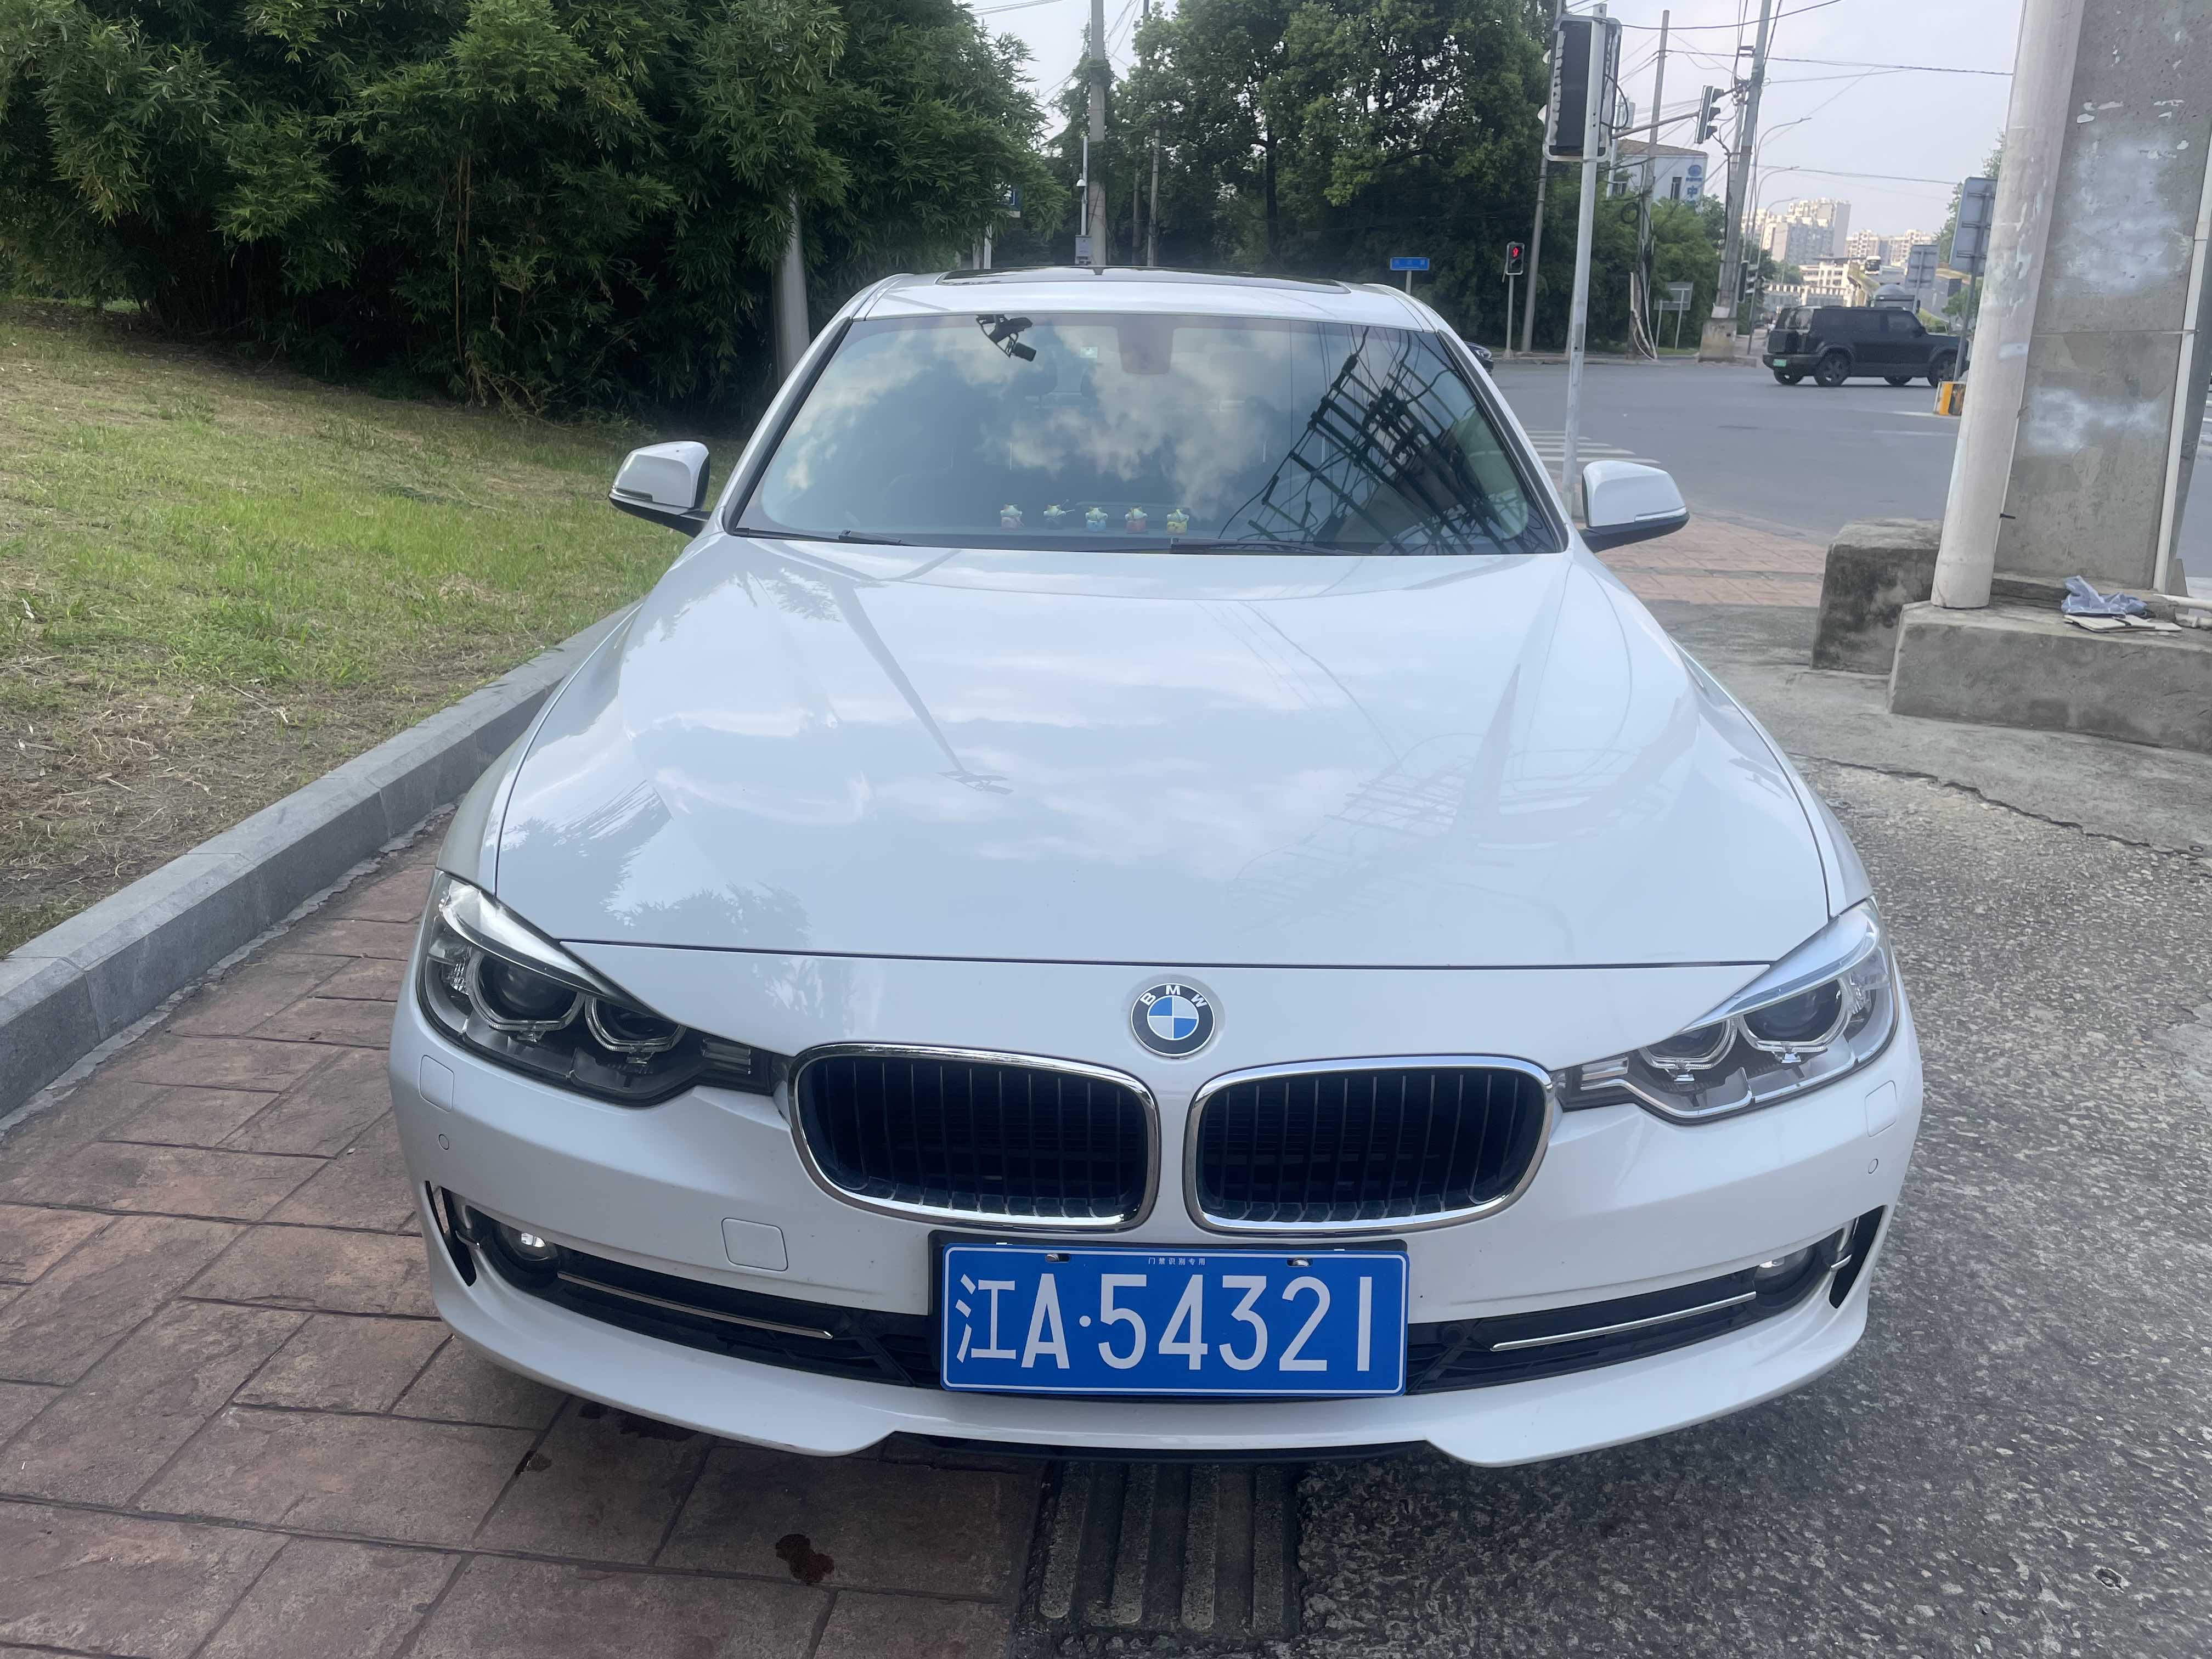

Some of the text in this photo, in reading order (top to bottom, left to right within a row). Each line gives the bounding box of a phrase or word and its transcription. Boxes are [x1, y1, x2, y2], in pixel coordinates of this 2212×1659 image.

[1140, 985, 1207, 1008] BMW
[1148, 1257, 1206, 1266] 门禁识别专用
